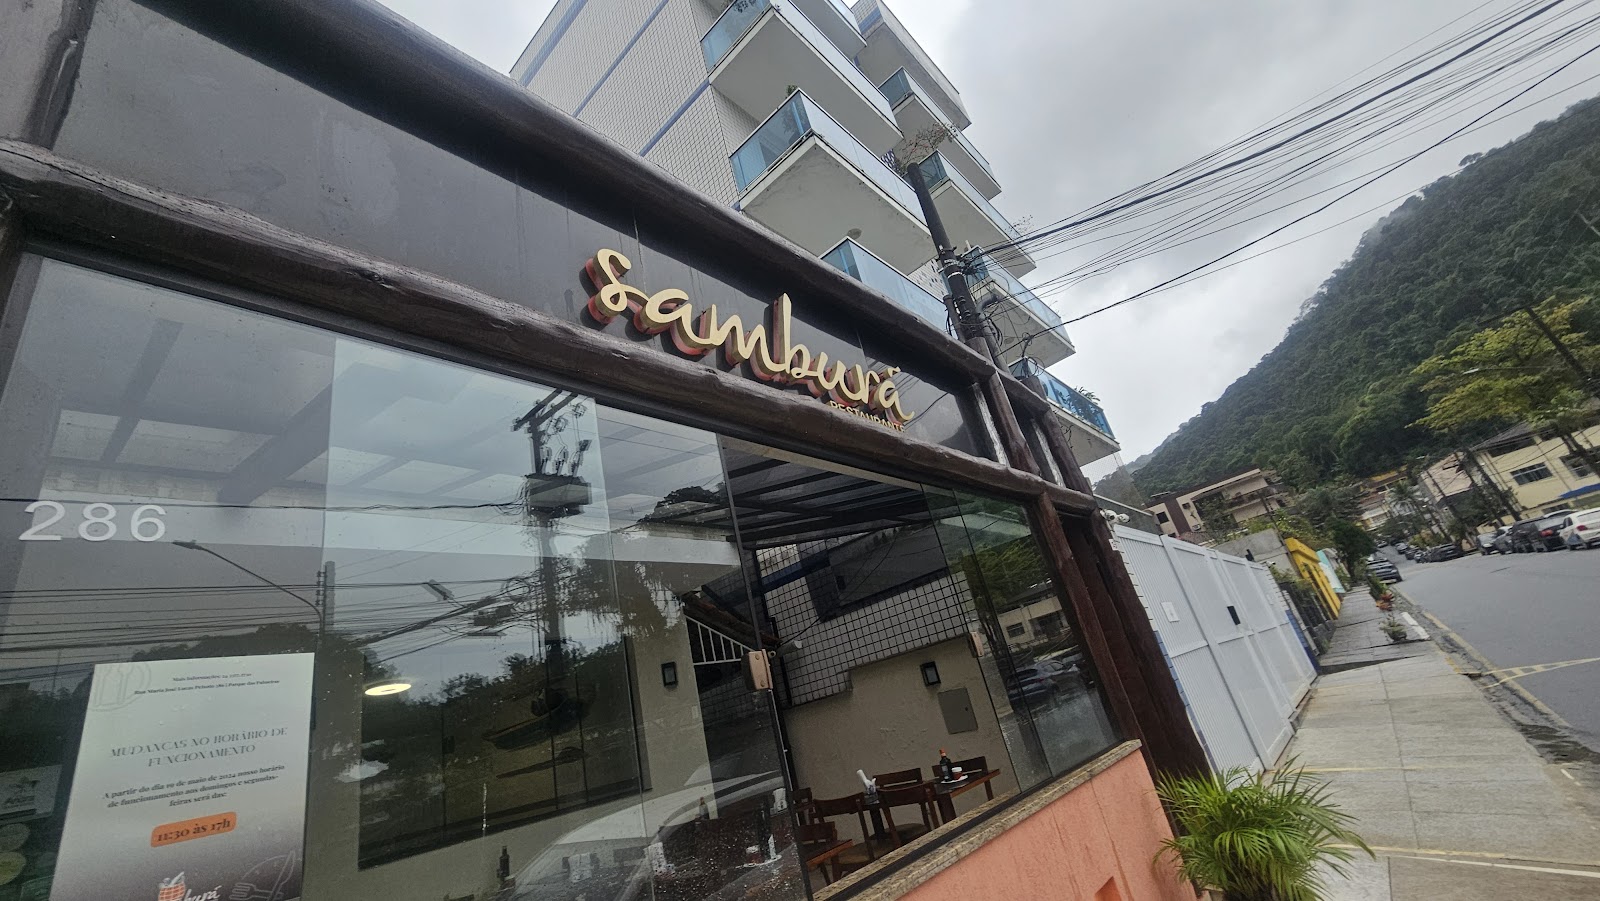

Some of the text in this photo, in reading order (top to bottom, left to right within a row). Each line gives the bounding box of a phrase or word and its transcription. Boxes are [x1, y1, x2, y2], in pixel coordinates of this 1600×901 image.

[18, 500, 167, 542] 286
[191, 736, 210, 746] NO
[271, 727, 288, 737] DE
[148, 744, 256, 767] FUNCIONAMENTO
[111, 788, 138, 798] partir
[138, 785, 150, 793] do
[151, 783, 165, 791] dia
[187, 777, 207, 785] maio
[237, 767, 259, 777] nosso
[259, 763, 285, 774] horário
[120, 790, 184, 806] funcionamento
[199, 781, 237, 793] domingos
[169, 798, 192, 807] feiras
[157, 818, 231, 842] 11:30 às 17h
